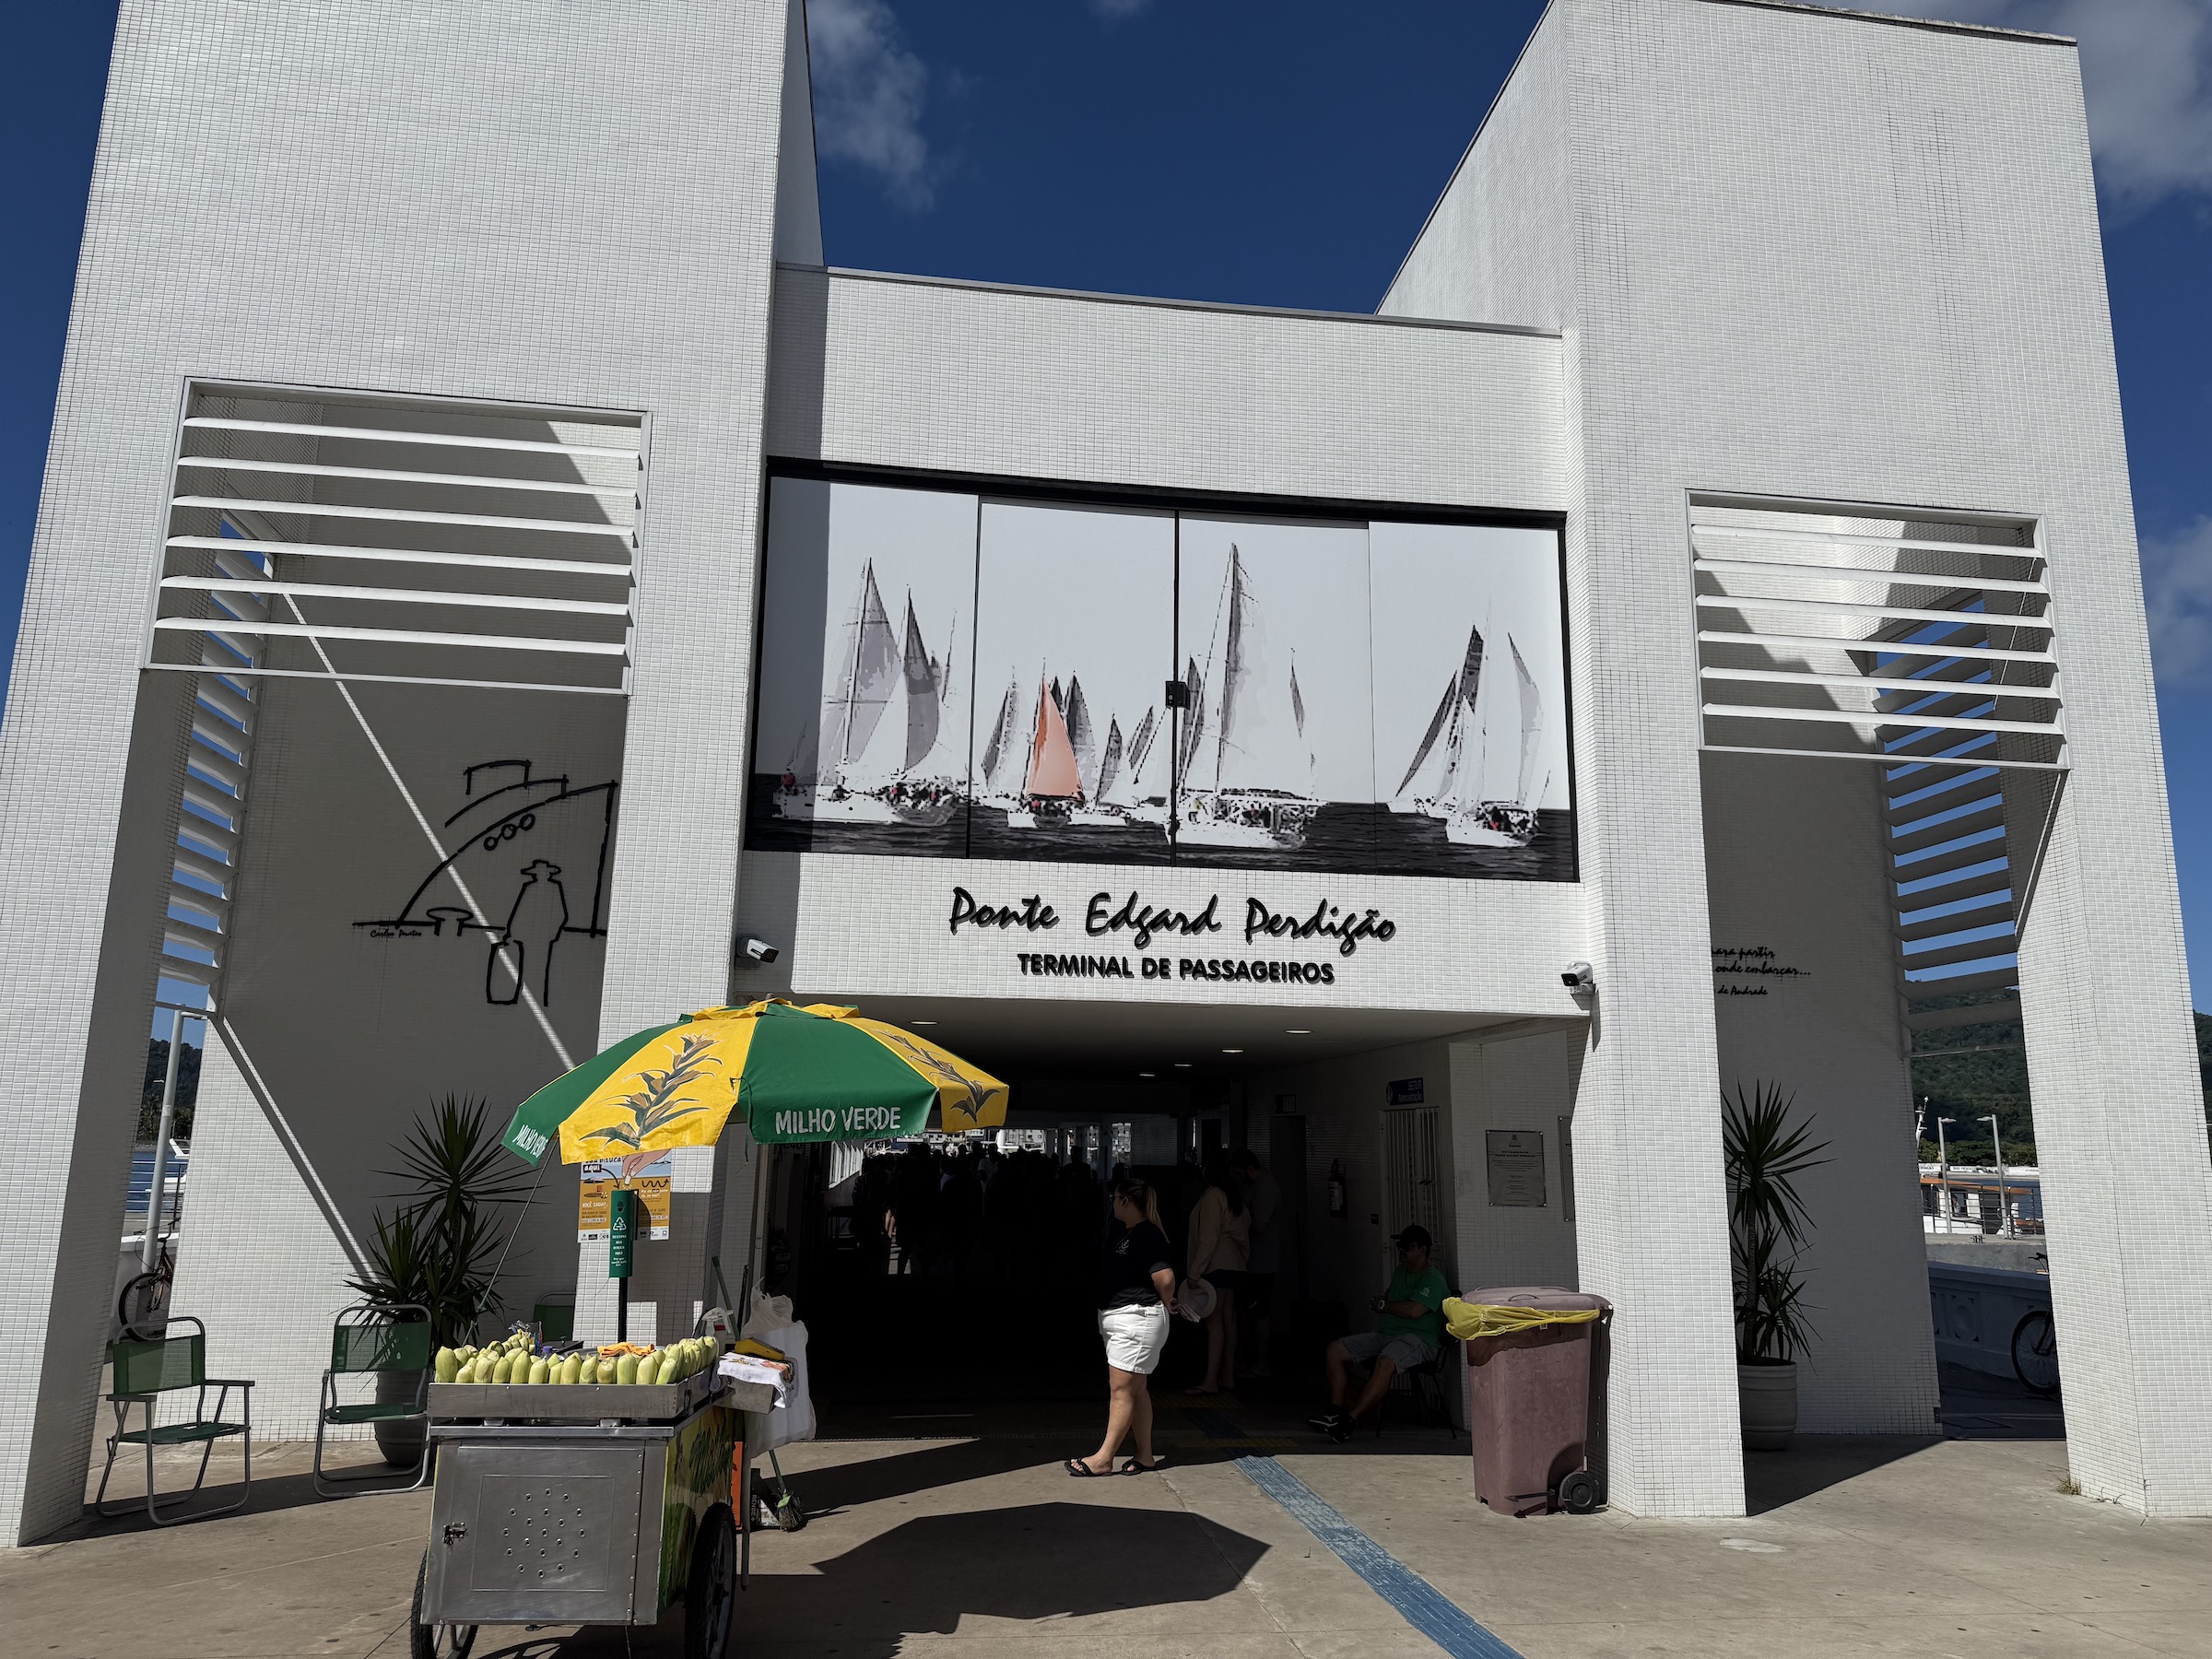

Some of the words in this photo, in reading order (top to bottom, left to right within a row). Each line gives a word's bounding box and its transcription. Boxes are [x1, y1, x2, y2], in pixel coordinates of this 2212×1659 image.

[948, 887, 1060, 935] Ponte
[1085, 891, 1222, 949] Edgard
[1246, 897, 1397, 956] Perdigão
[370, 929, 395, 938] Carlos
[1737, 946, 1776, 960] partir
[1018, 953, 1134, 979] TERMINAL
[1141, 958, 1171, 980] DE
[1179, 959, 1335, 985] PASSAGEIROS
[1717, 984, 1729, 994] de
[1730, 984, 1769, 995] Andrade
[1407, 1079, 1422, 1090] SETUR
[775, 1108, 837, 1135] MILHO
[841, 1106, 902, 1133] VERDE
